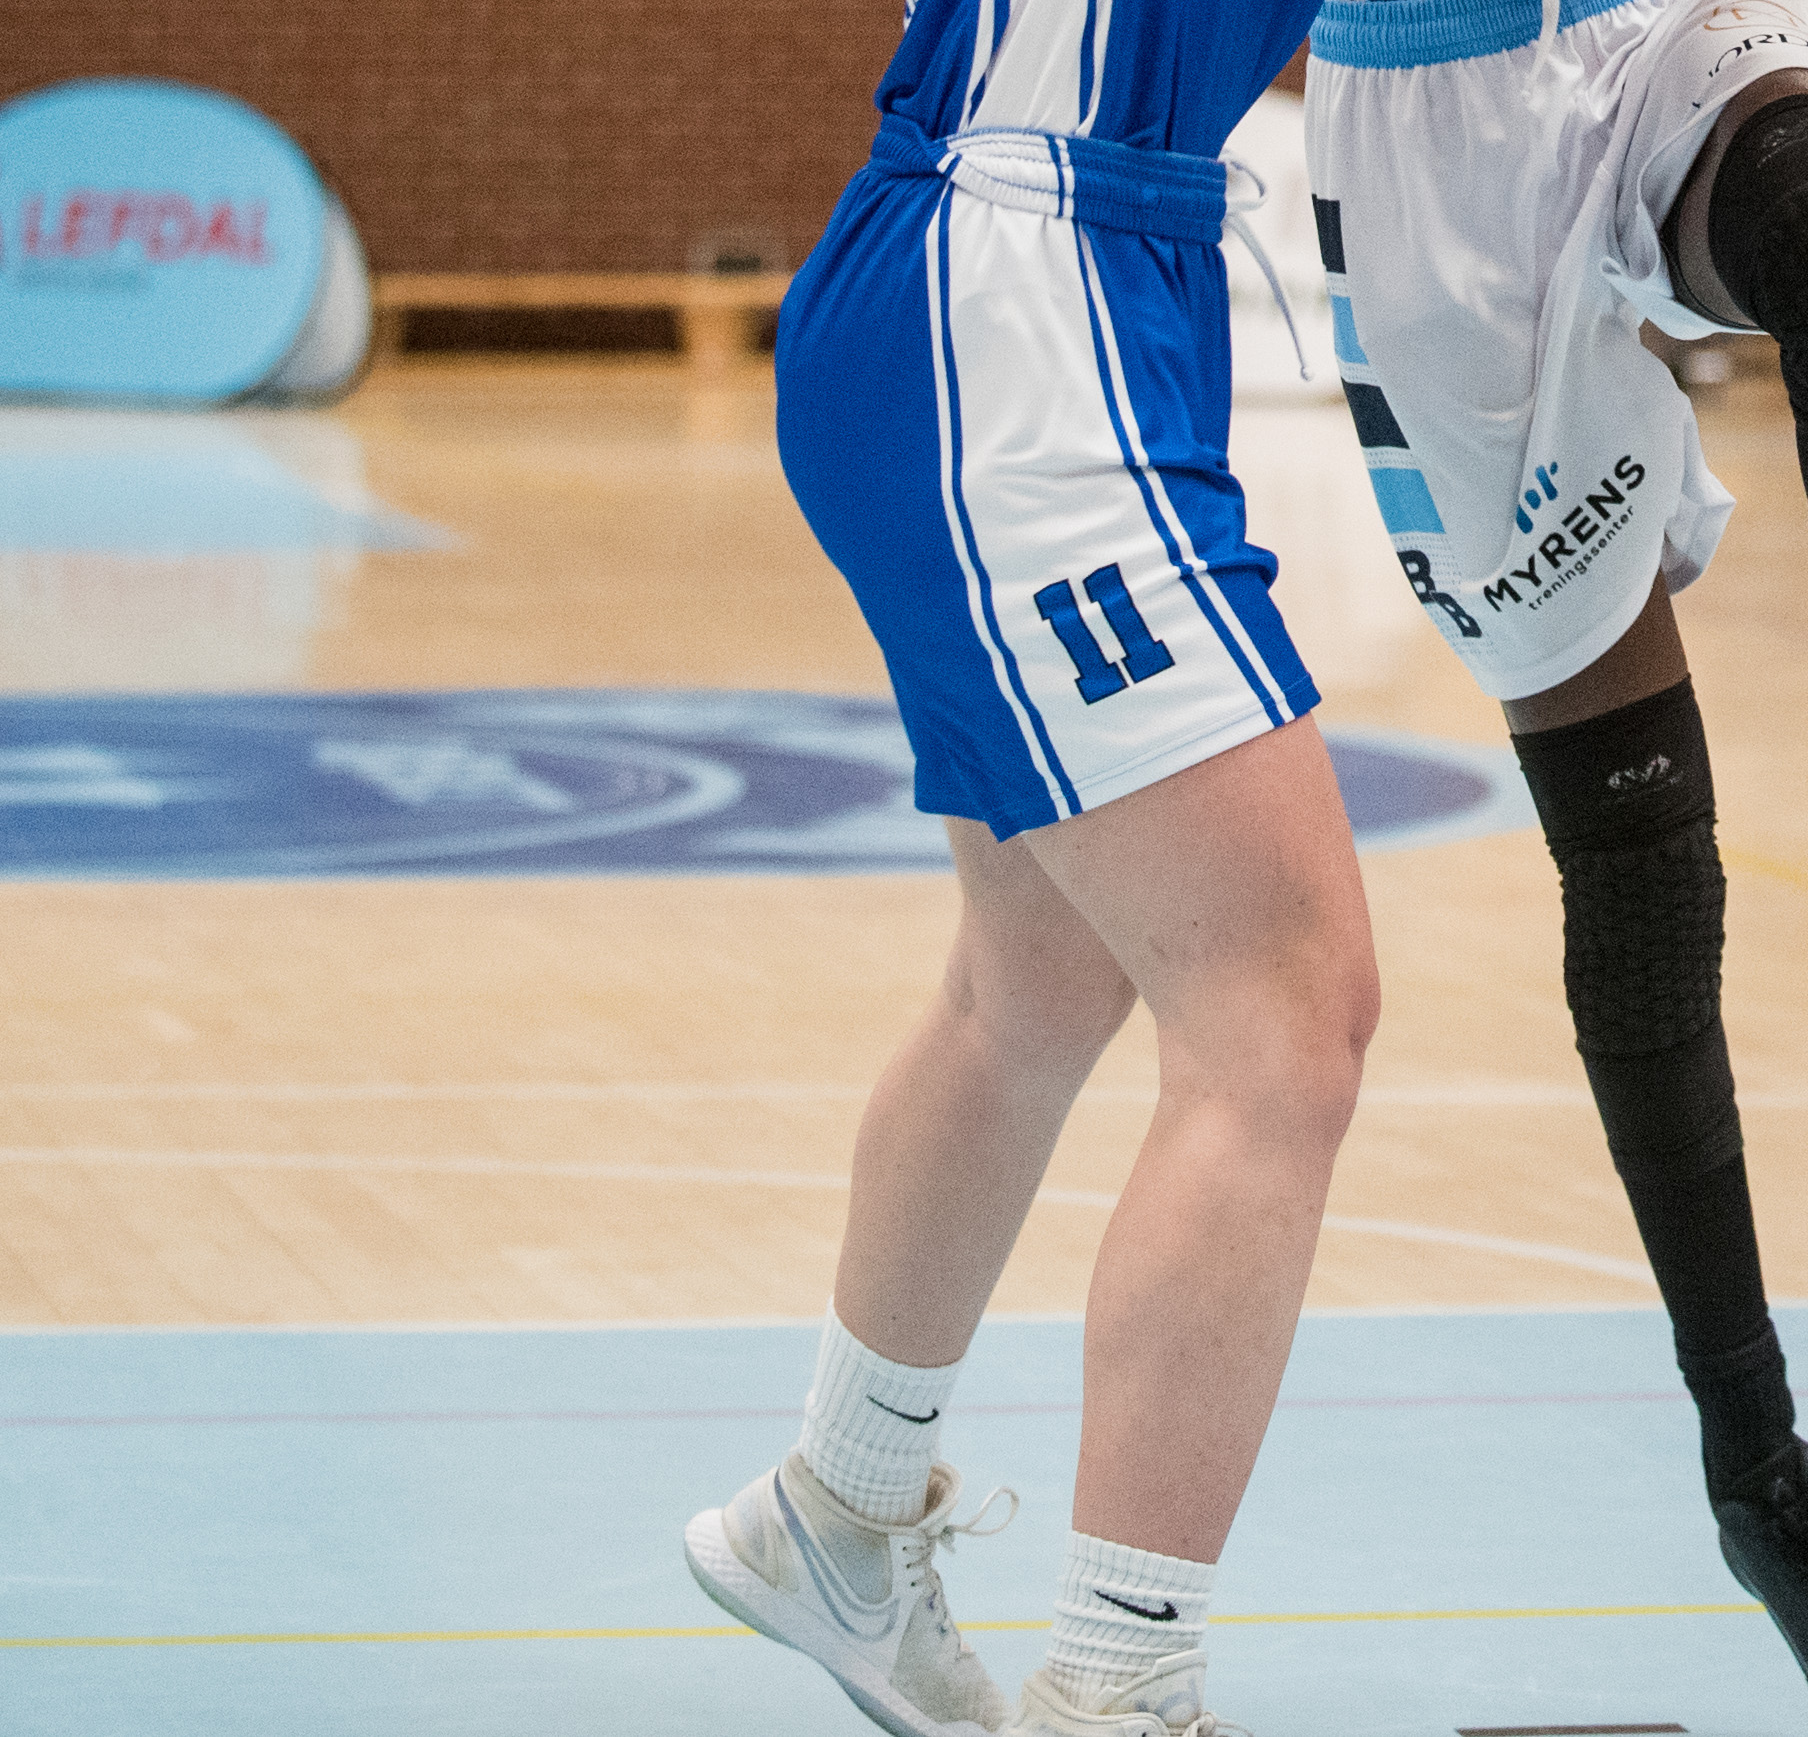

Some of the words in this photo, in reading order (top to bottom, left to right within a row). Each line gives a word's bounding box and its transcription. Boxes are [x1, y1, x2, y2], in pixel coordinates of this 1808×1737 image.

[1483, 454, 1646, 613] MYRENS
[1528, 504, 1635, 611] treningssenter
[1033, 561, 1177, 706] 11
